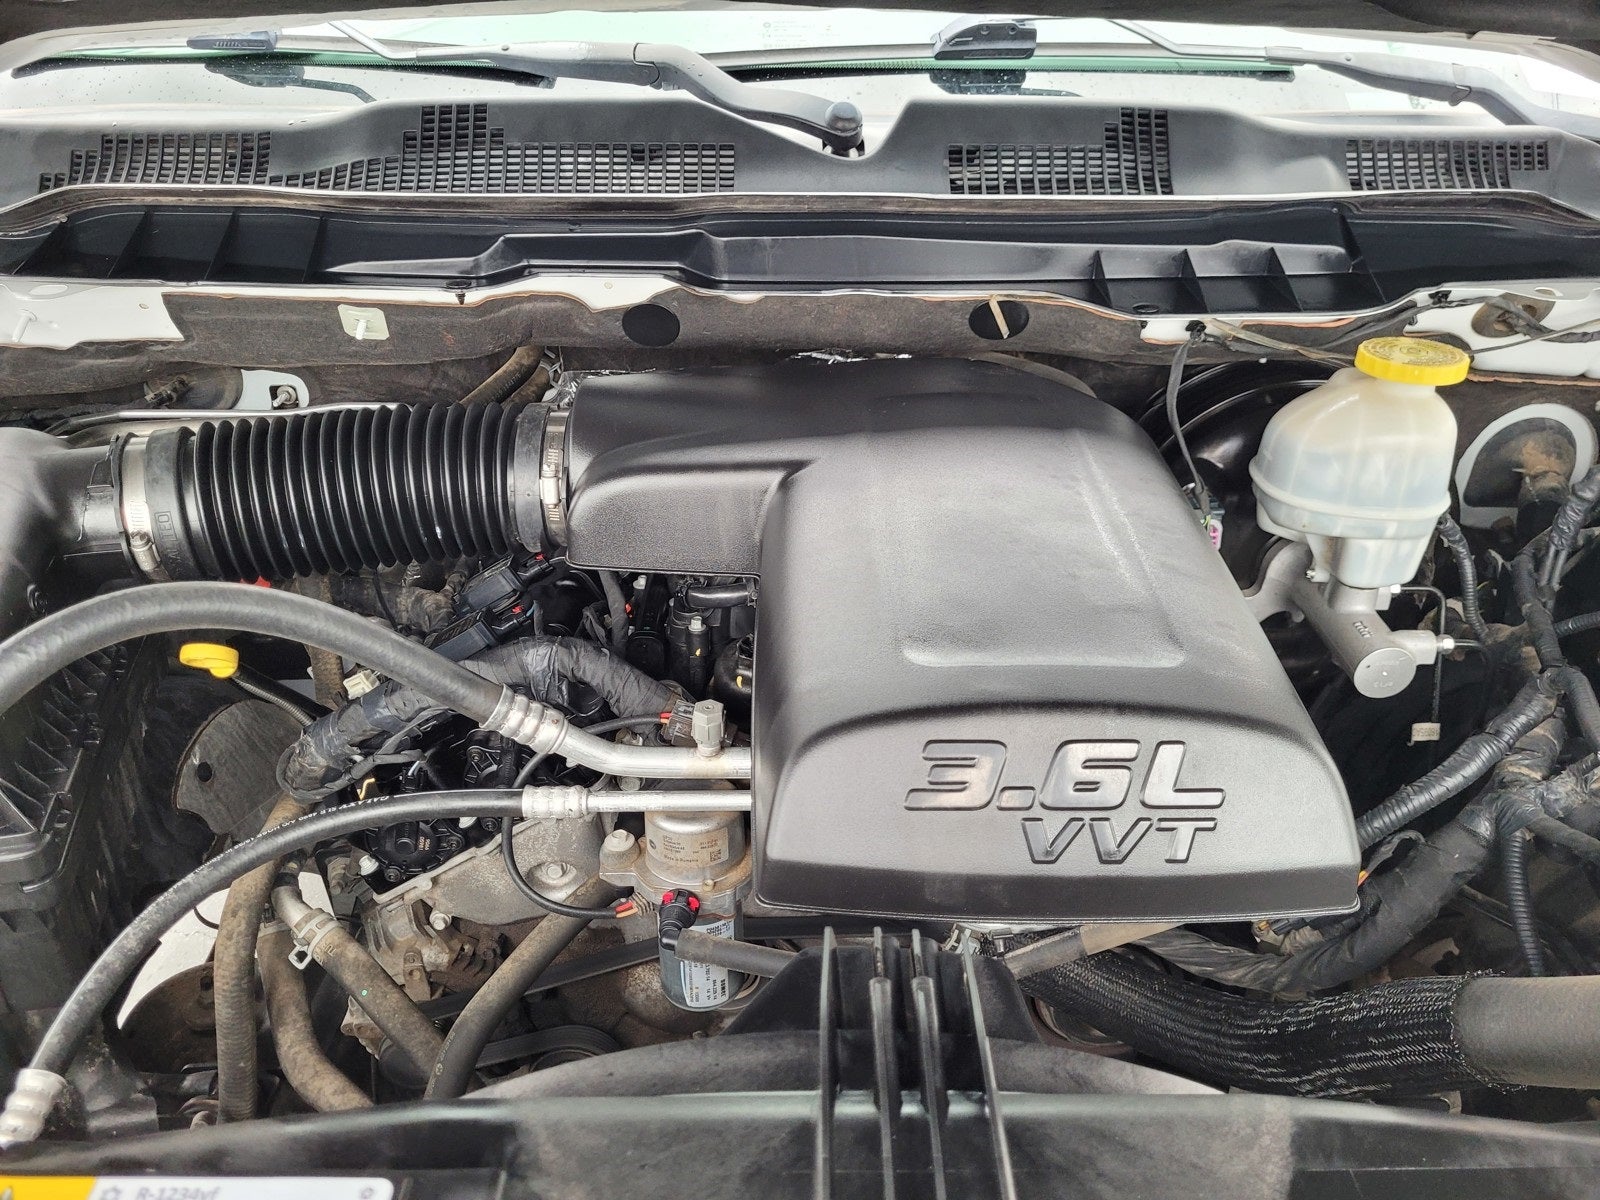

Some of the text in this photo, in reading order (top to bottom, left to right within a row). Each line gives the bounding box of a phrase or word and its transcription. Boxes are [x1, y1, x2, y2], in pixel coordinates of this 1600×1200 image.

[903, 738, 1227, 811] 3.6L
[339, 795, 390, 811] GALAXY
[1020, 816, 1219, 865] VVT
